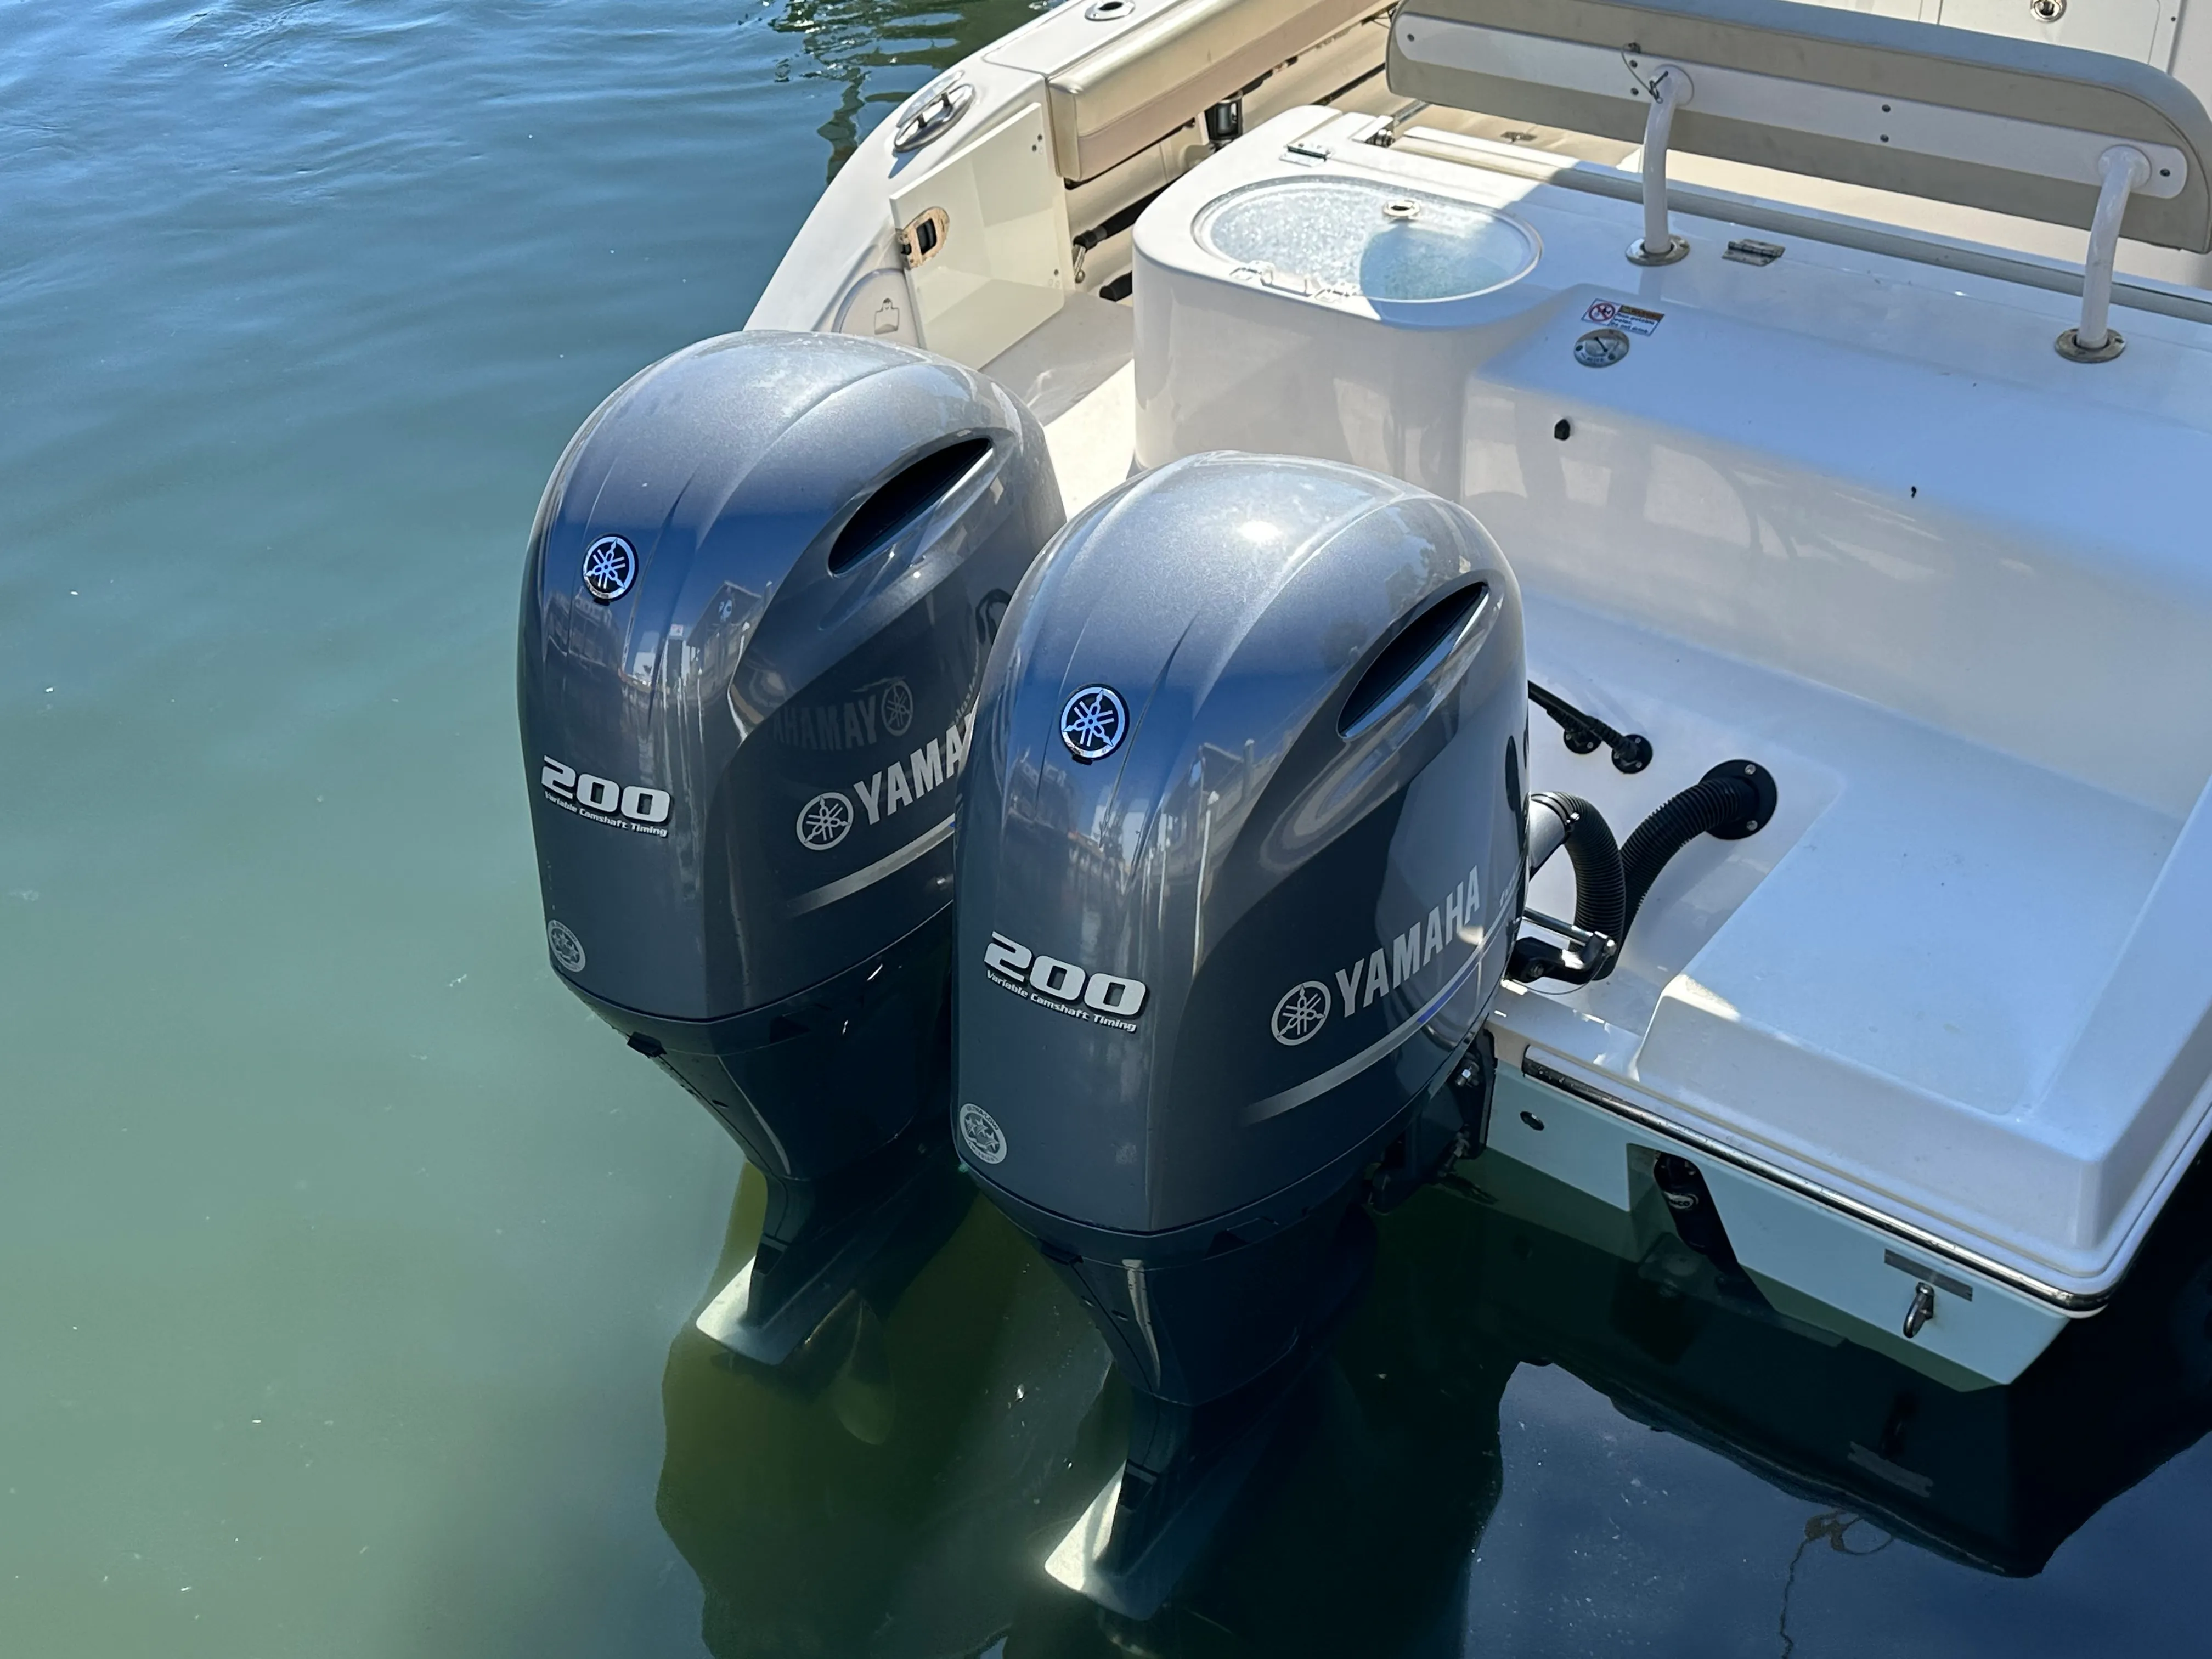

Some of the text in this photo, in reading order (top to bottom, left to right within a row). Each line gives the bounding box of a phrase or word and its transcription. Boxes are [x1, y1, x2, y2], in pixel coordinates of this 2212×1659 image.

[541, 755, 671, 823] 200
[853, 711, 973, 825] YAMA
[544, 791, 668, 837] Variable Camshaft Timing
[983, 930, 1147, 1015] 200
[1335, 865, 1480, 1018] YAMAHA
[987, 969, 1137, 1033] Variable Camshaft Timing
